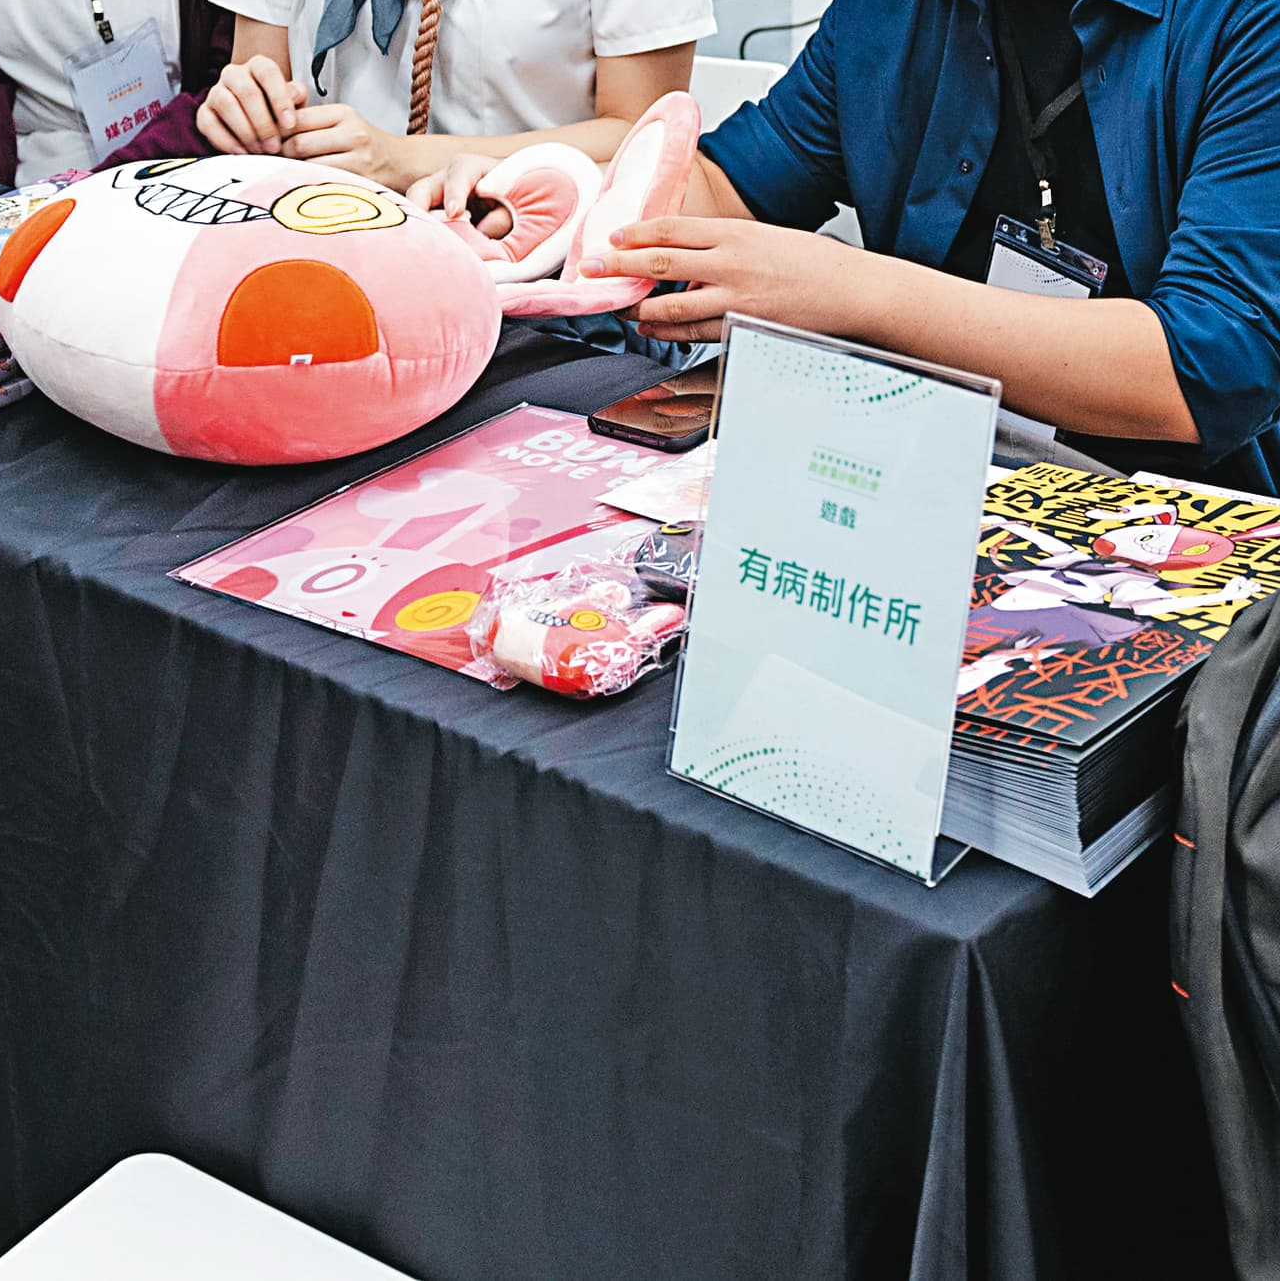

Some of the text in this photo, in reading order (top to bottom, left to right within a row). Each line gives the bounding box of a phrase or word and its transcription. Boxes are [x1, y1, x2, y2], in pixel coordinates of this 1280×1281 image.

[495, 445, 599, 480] NOTE
[819, 497, 857, 530] 遊戲
[738, 546, 922, 646] 有病制作所
